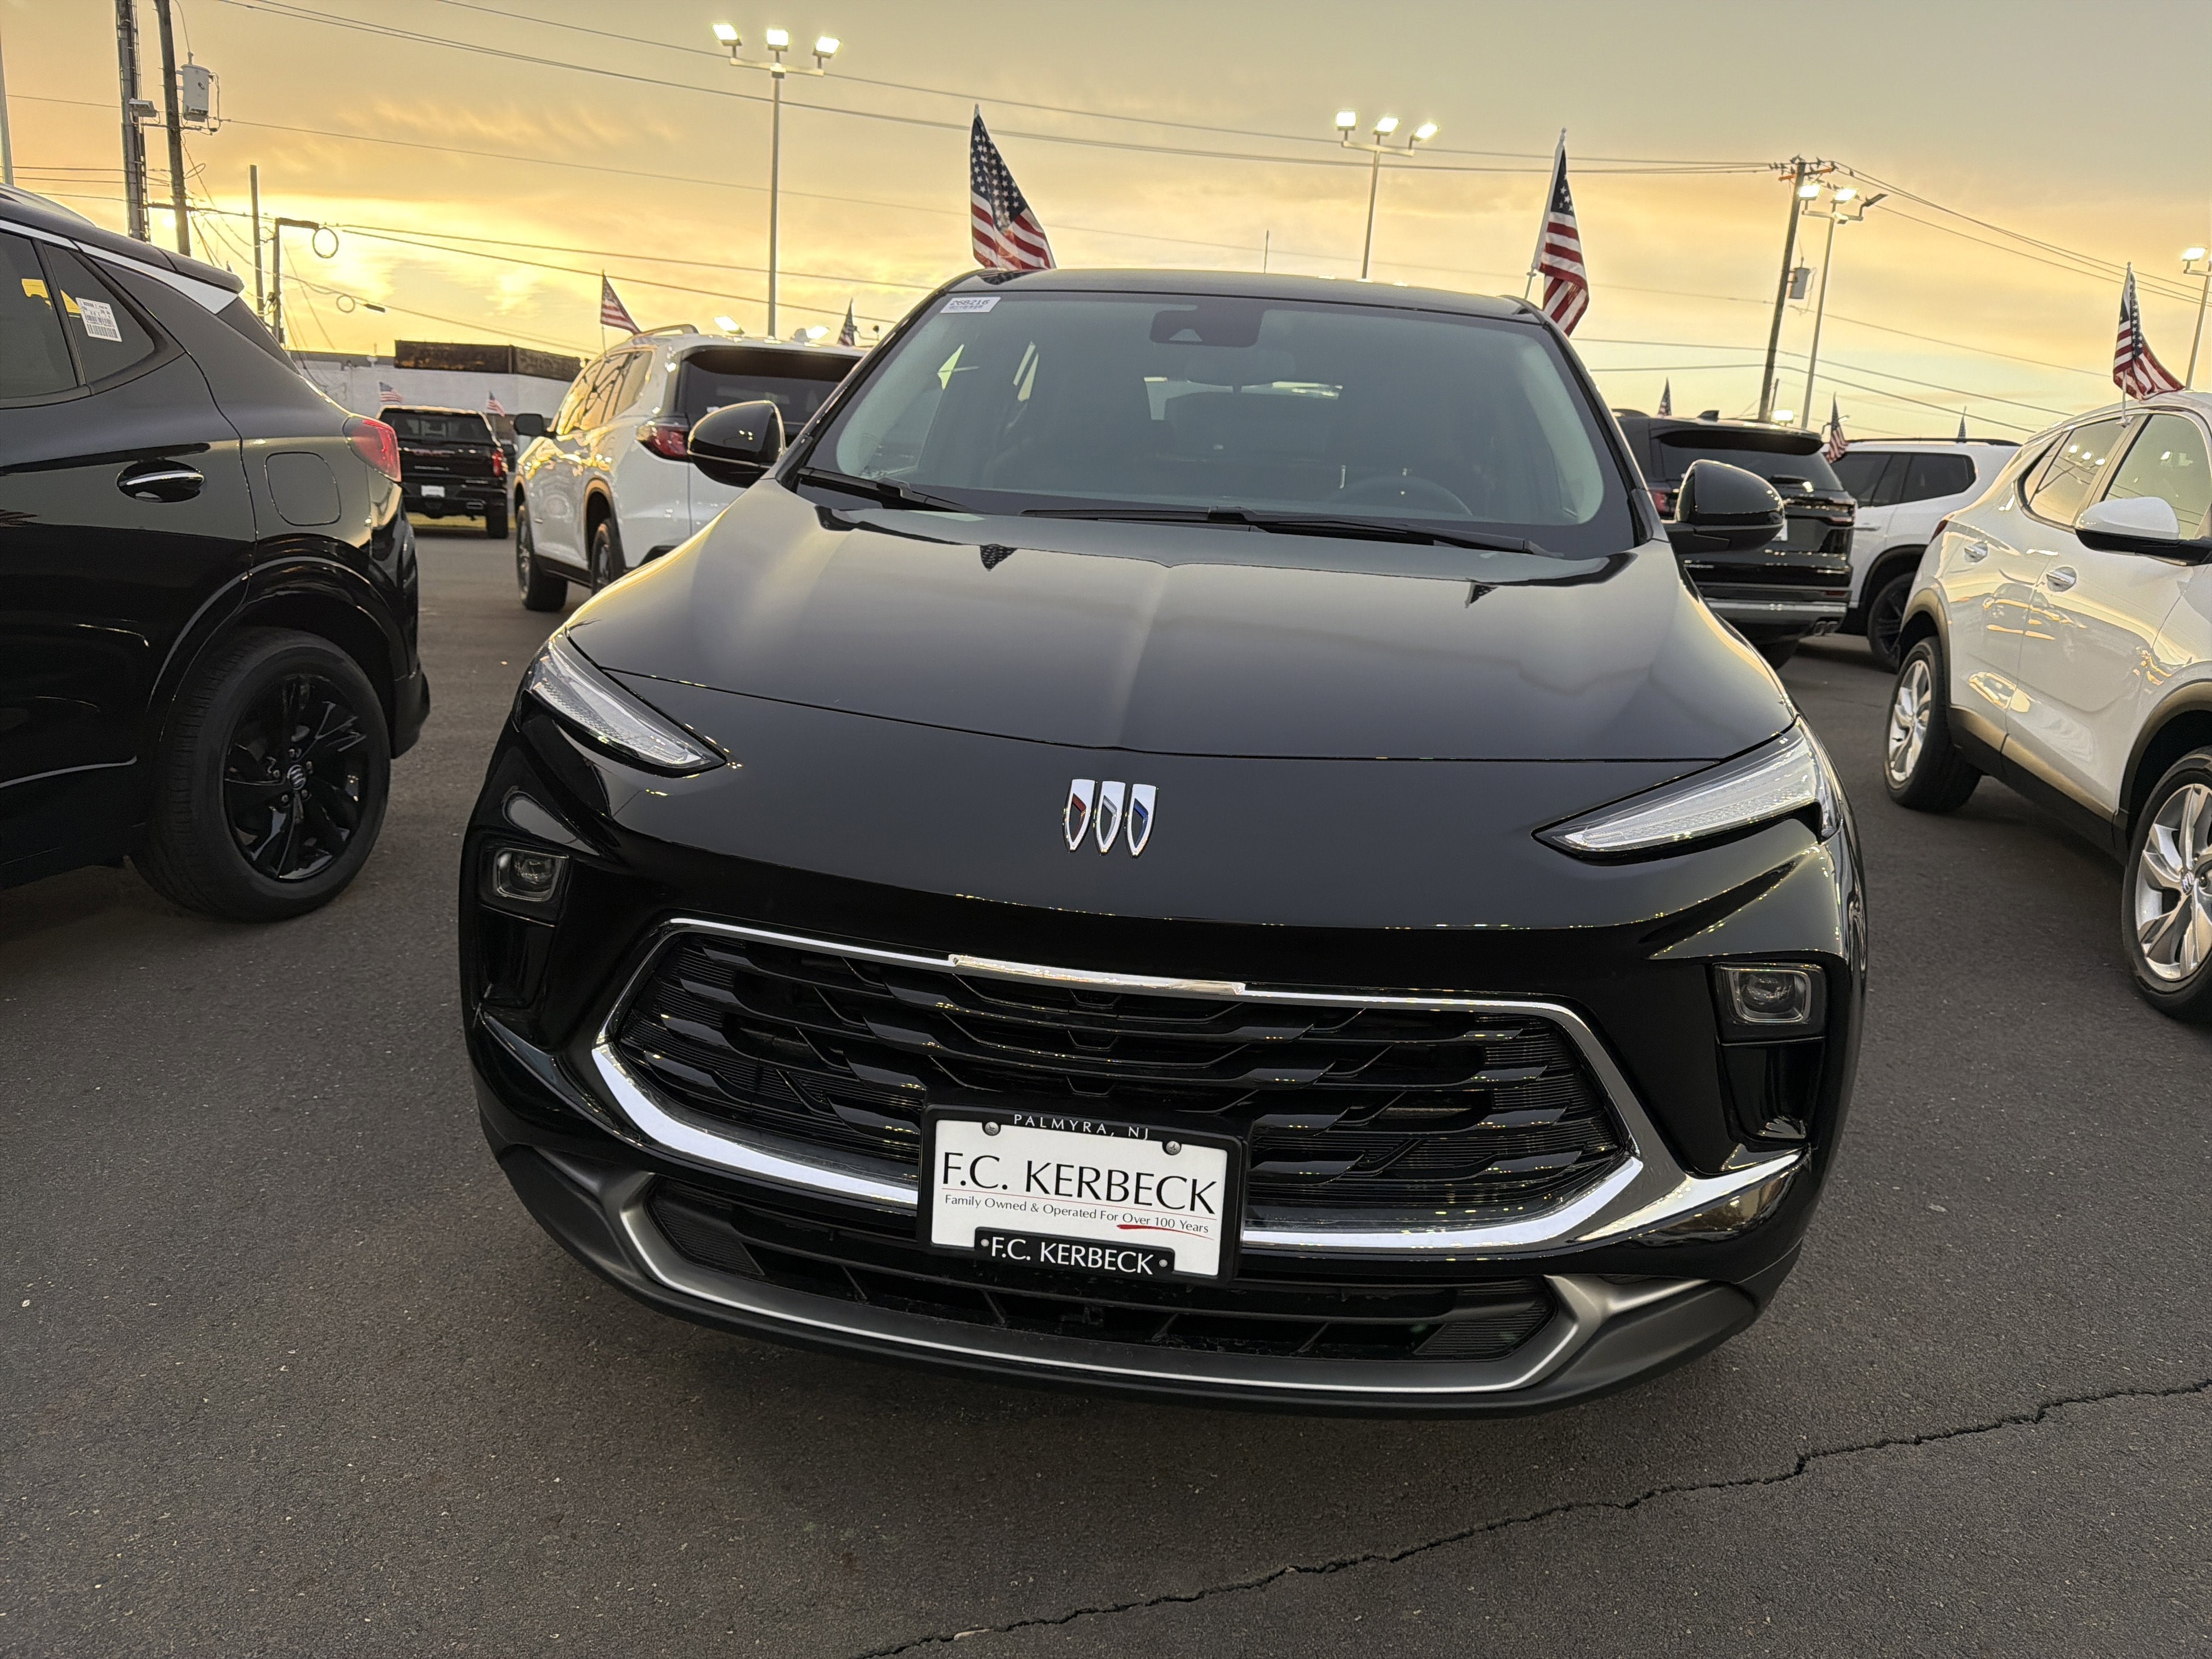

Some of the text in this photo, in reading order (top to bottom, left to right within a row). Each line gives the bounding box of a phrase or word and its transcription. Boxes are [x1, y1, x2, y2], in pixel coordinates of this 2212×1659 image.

[1014, 1114, 1149, 1140] PALMYRA, NJ
[943, 1152, 1217, 1215] F.C. KERBECK
[945, 1194, 1209, 1233] Family Owned & Operated For Over 100 Years
[991, 1236, 1154, 1275] F.C. KERBECK
